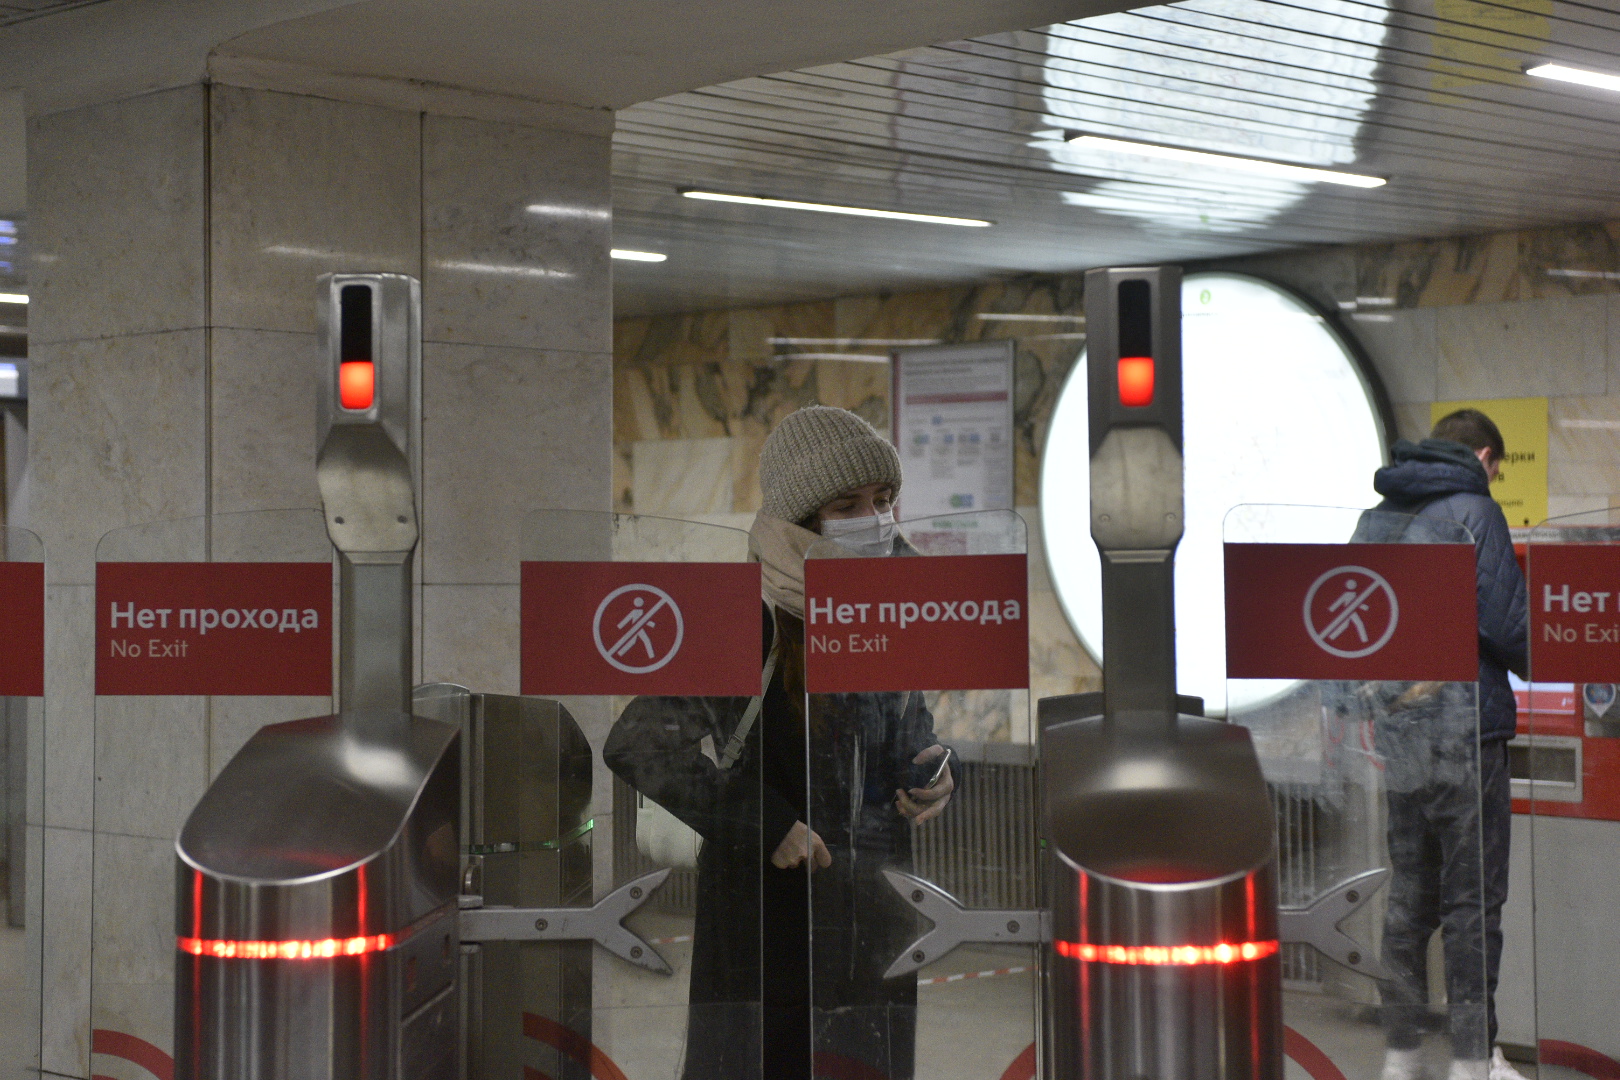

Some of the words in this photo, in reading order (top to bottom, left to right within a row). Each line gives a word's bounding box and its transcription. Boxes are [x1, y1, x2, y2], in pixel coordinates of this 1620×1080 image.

[1543, 583, 1611, 613] Нет
[110, 601, 173, 629] Нет
[179, 608, 319, 635] прохода
[810, 596, 872, 625] Нет
[878, 599, 1021, 630] прохода
[810, 634, 842, 654] No
[848, 633, 889, 653] Exit
[1543, 623, 1577, 643] No
[110, 639, 142, 658] No
[148, 639, 189, 658] Exit
